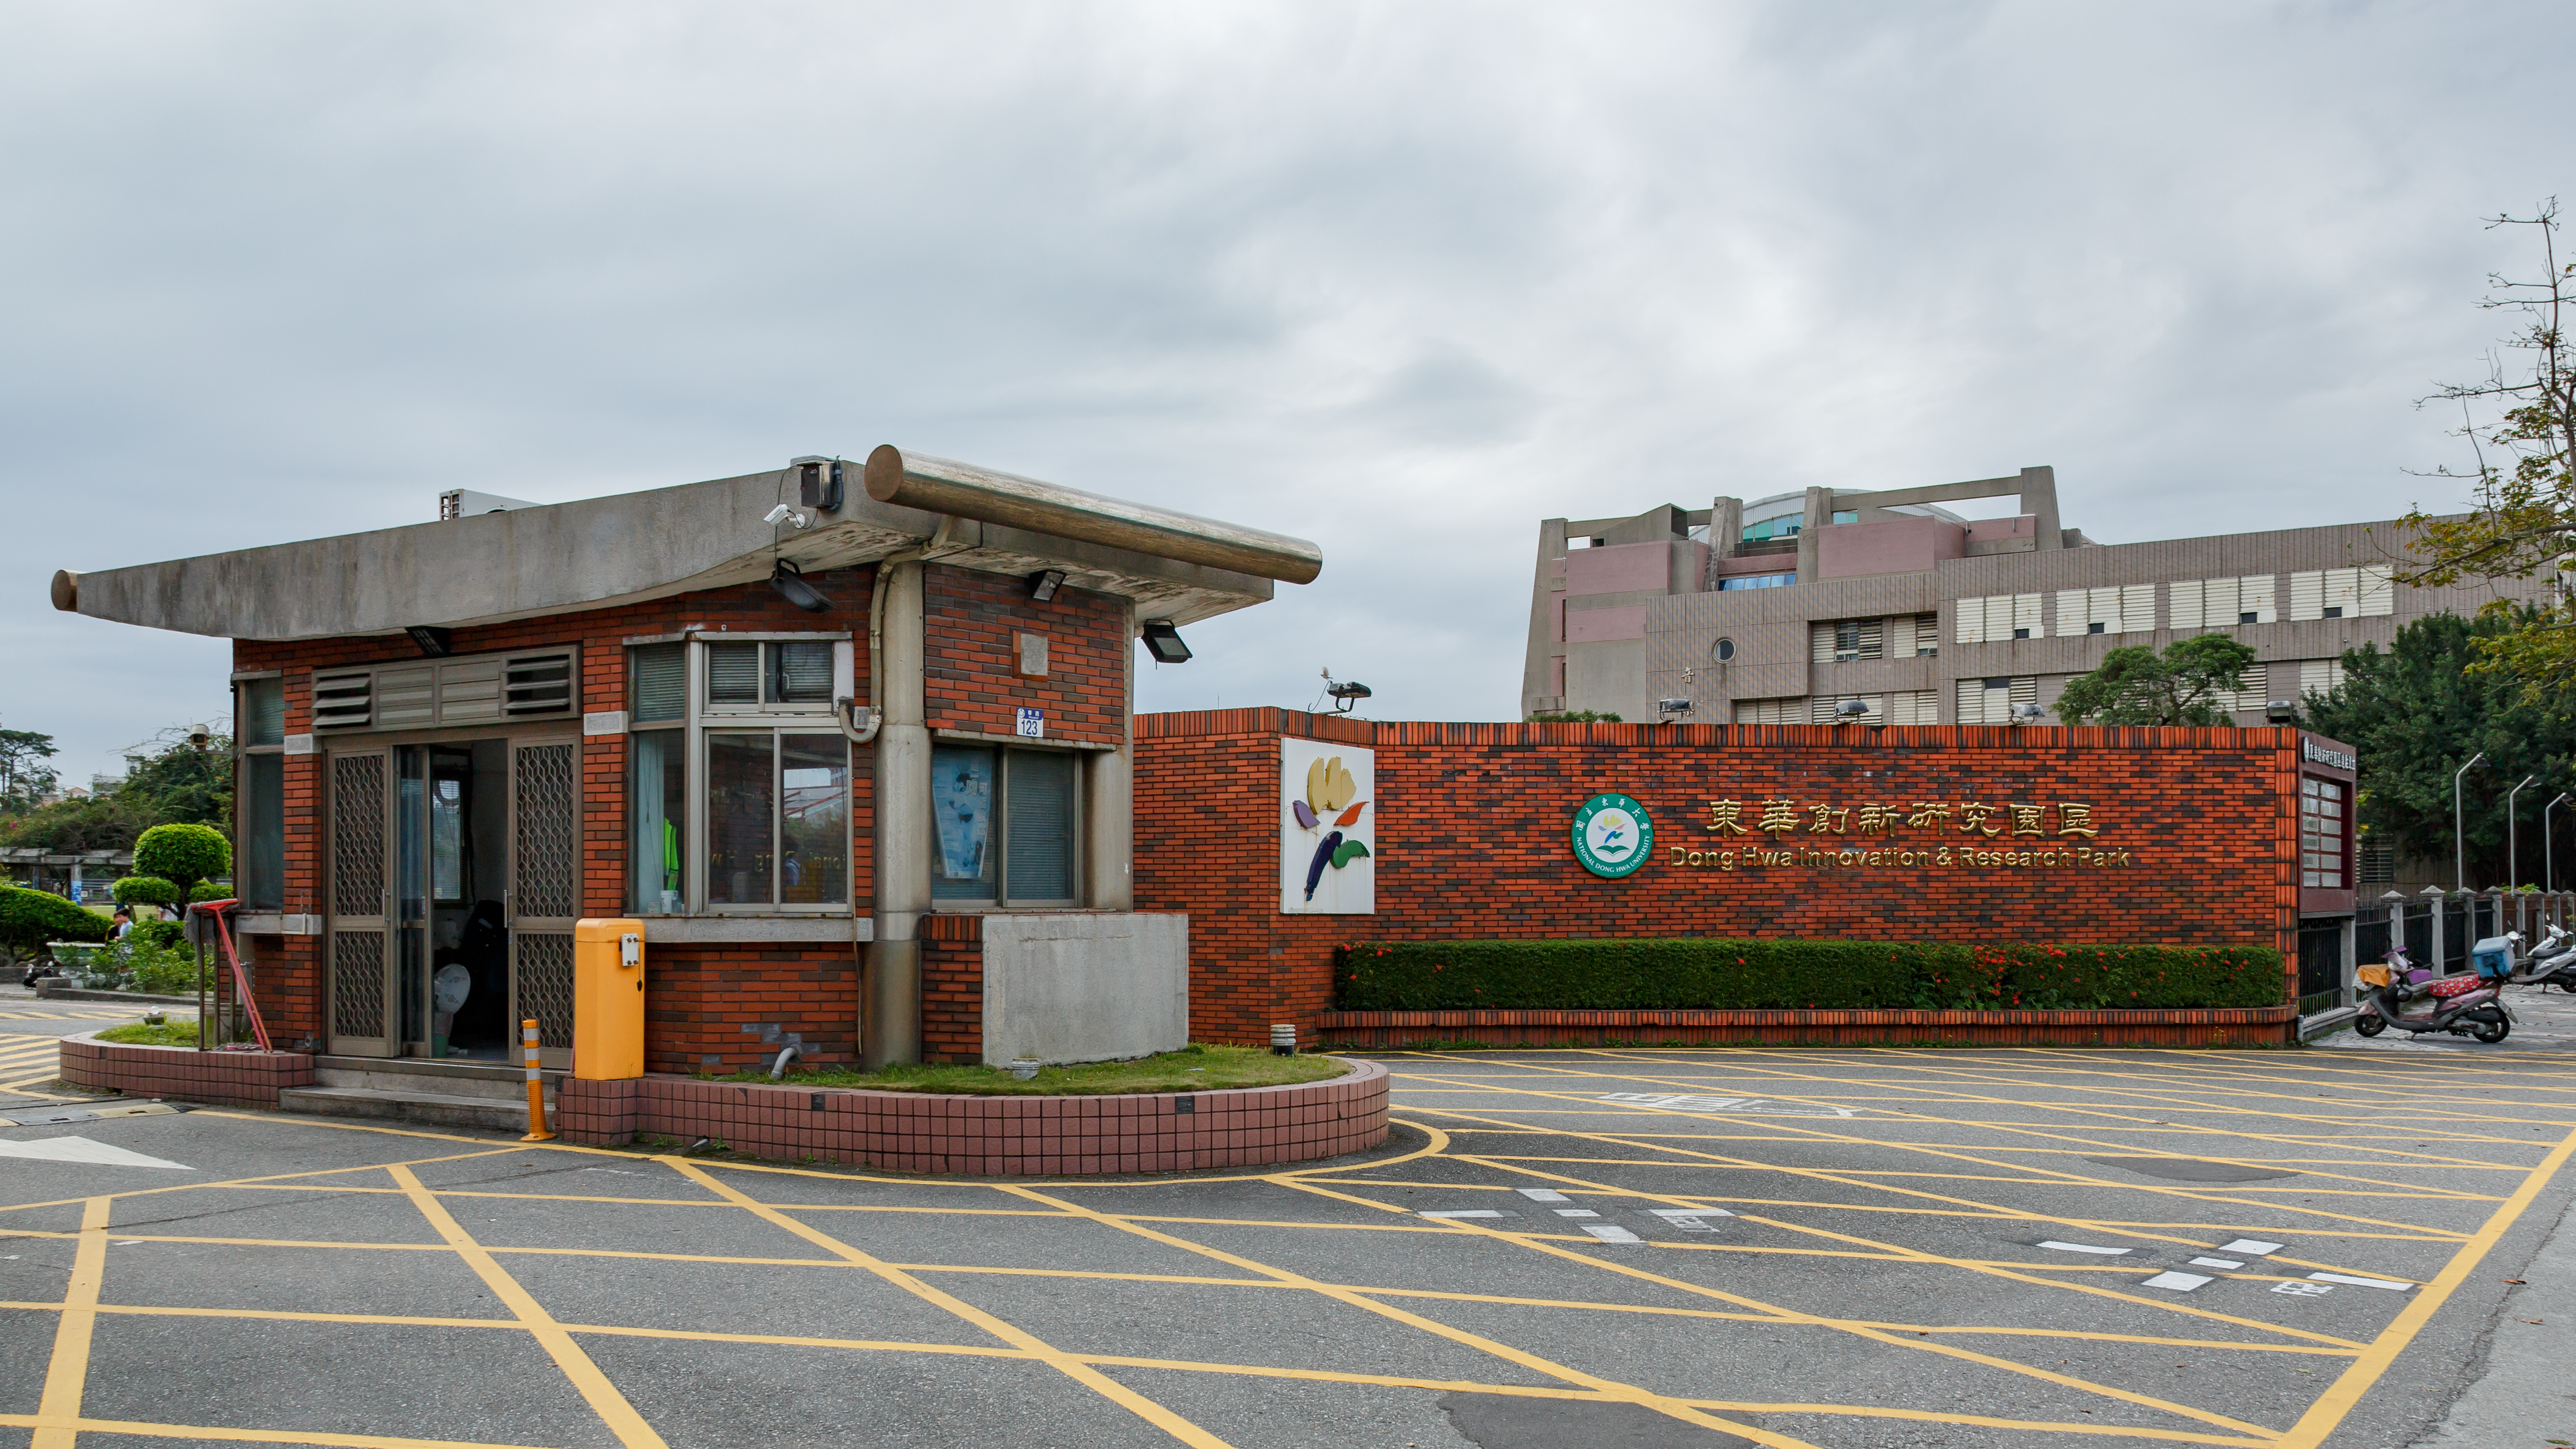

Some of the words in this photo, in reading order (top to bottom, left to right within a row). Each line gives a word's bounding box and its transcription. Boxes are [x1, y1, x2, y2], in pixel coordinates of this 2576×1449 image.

[1021, 719, 1038, 735] 123
[1706, 798, 2099, 840] 東華創新研究園區
[1577, 836, 1596, 866] NATIONAL
[1595, 863, 1614, 873] DONG
[1629, 835, 1650, 867] UNIVERSITY
[1670, 846, 1734, 871] Dong
[1742, 846, 1792, 867] Hwa
[1800, 846, 1929, 867] Innovation
[1936, 847, 1952, 867] &
[1959, 847, 2071, 867] Research
[2077, 847, 2130, 867] Park
